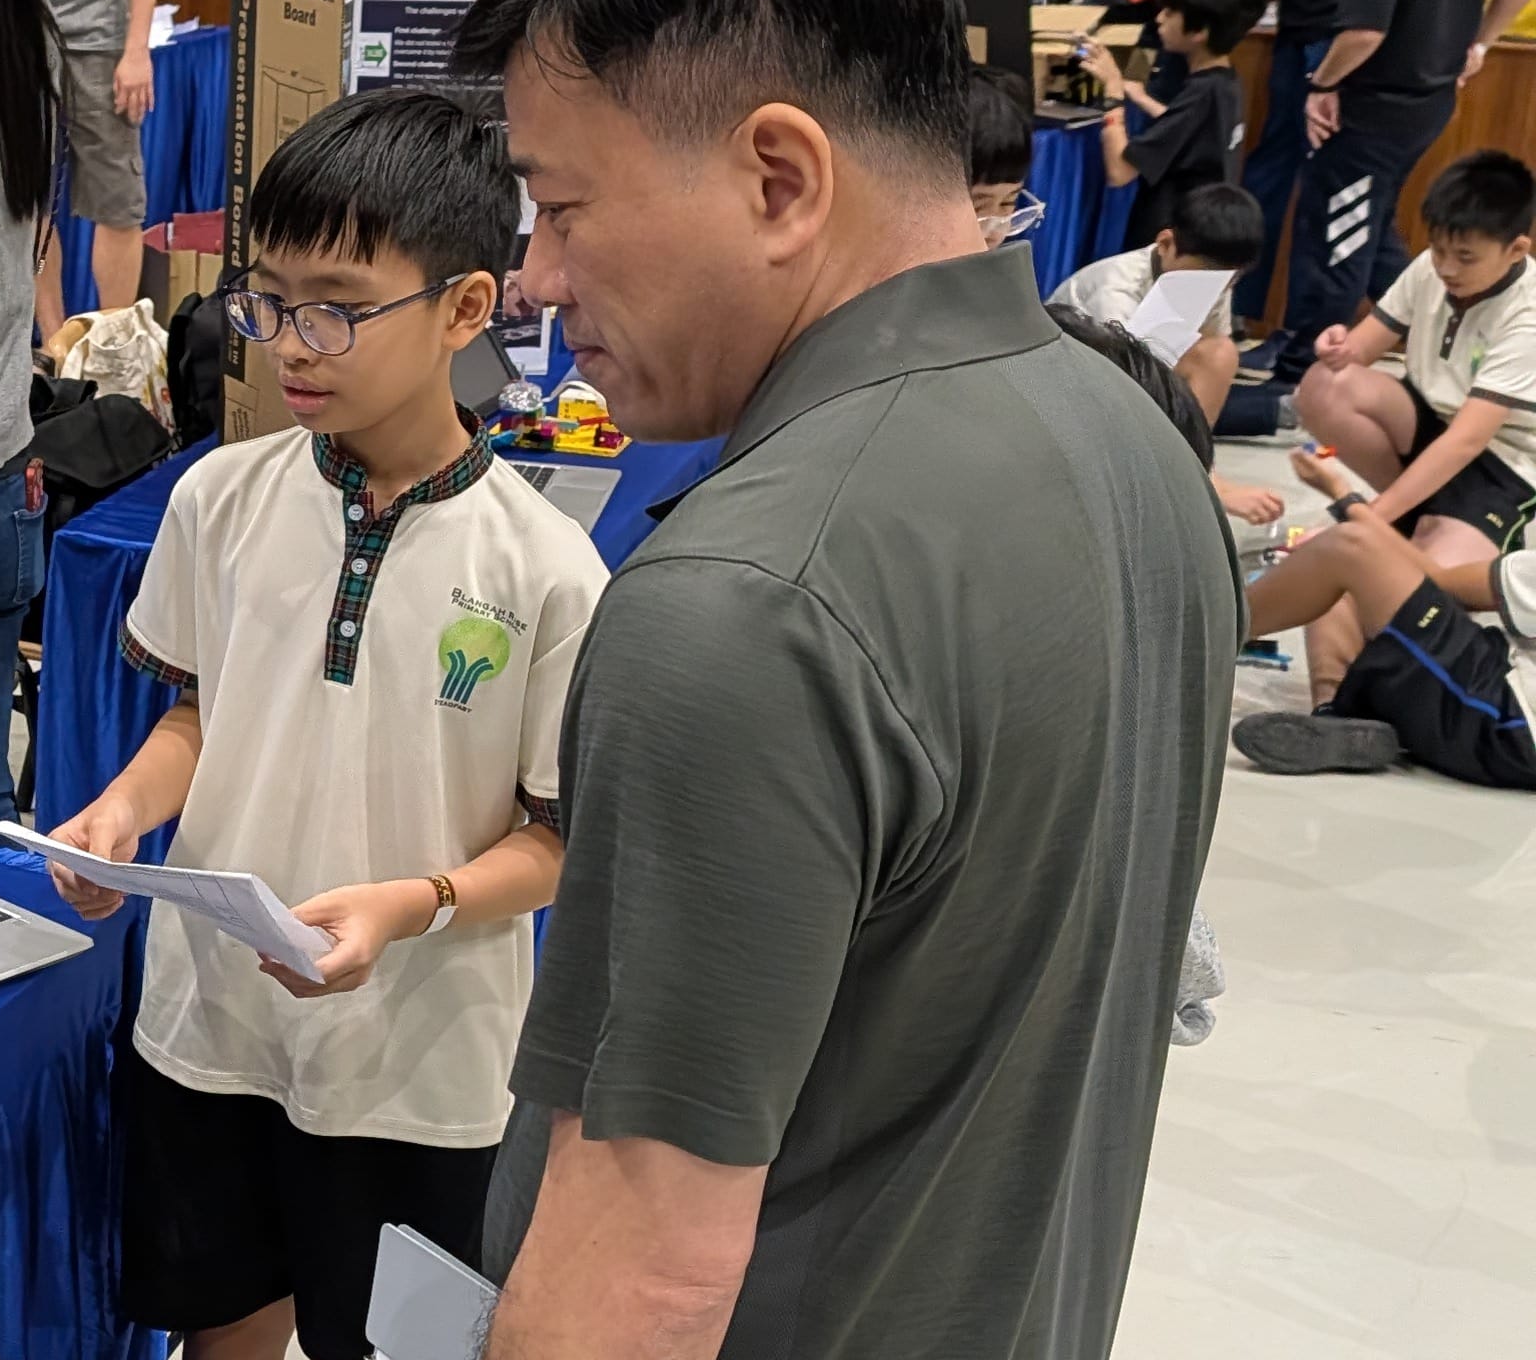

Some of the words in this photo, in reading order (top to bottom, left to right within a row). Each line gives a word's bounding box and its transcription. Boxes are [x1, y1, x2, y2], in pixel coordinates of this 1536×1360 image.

[284, 2, 317, 27] Board
[231, 185, 244, 267] Board
[451, 587, 506, 616] BLANGAH
[451, 598, 491, 619] PRIMARY
